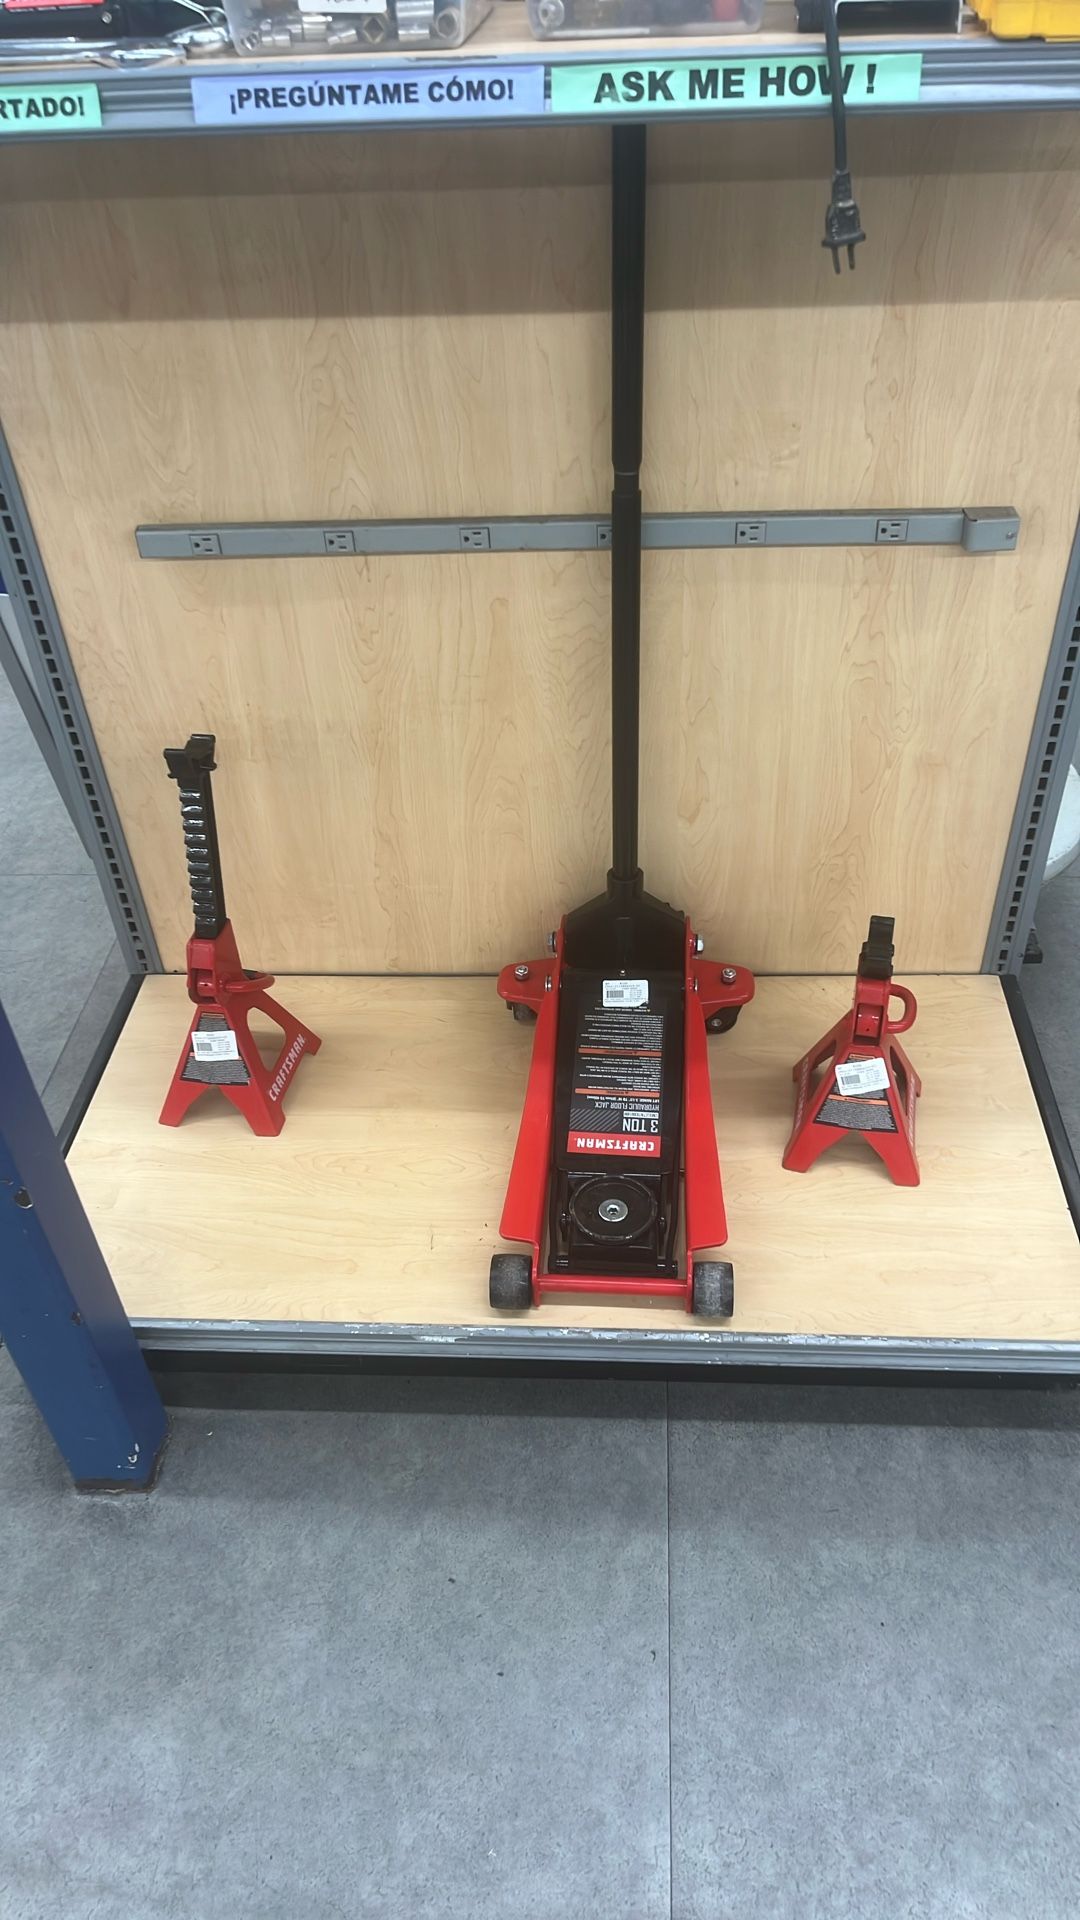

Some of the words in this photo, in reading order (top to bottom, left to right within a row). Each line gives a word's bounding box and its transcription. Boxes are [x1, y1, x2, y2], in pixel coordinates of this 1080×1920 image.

[593, 69, 675, 104] ASK
[688, 67, 746, 100] ME
[759, 64, 855, 97] HOW
[229, 77, 419, 115] ¡PREGÚNTAME
[428, 75, 515, 103] CÓMO!
[268, 1033, 307, 1102] CRAFTSMAN
[595, 1101, 610, 1109] JACK
[610, 1102, 628, 1110] FLOOR
[629, 1102, 660, 1111] HYDRAULIC
[622, 1118, 647, 1132] TON
[650, 1119, 659, 1133] 3
[577, 1137, 655, 1152] CRAFTSMAN
